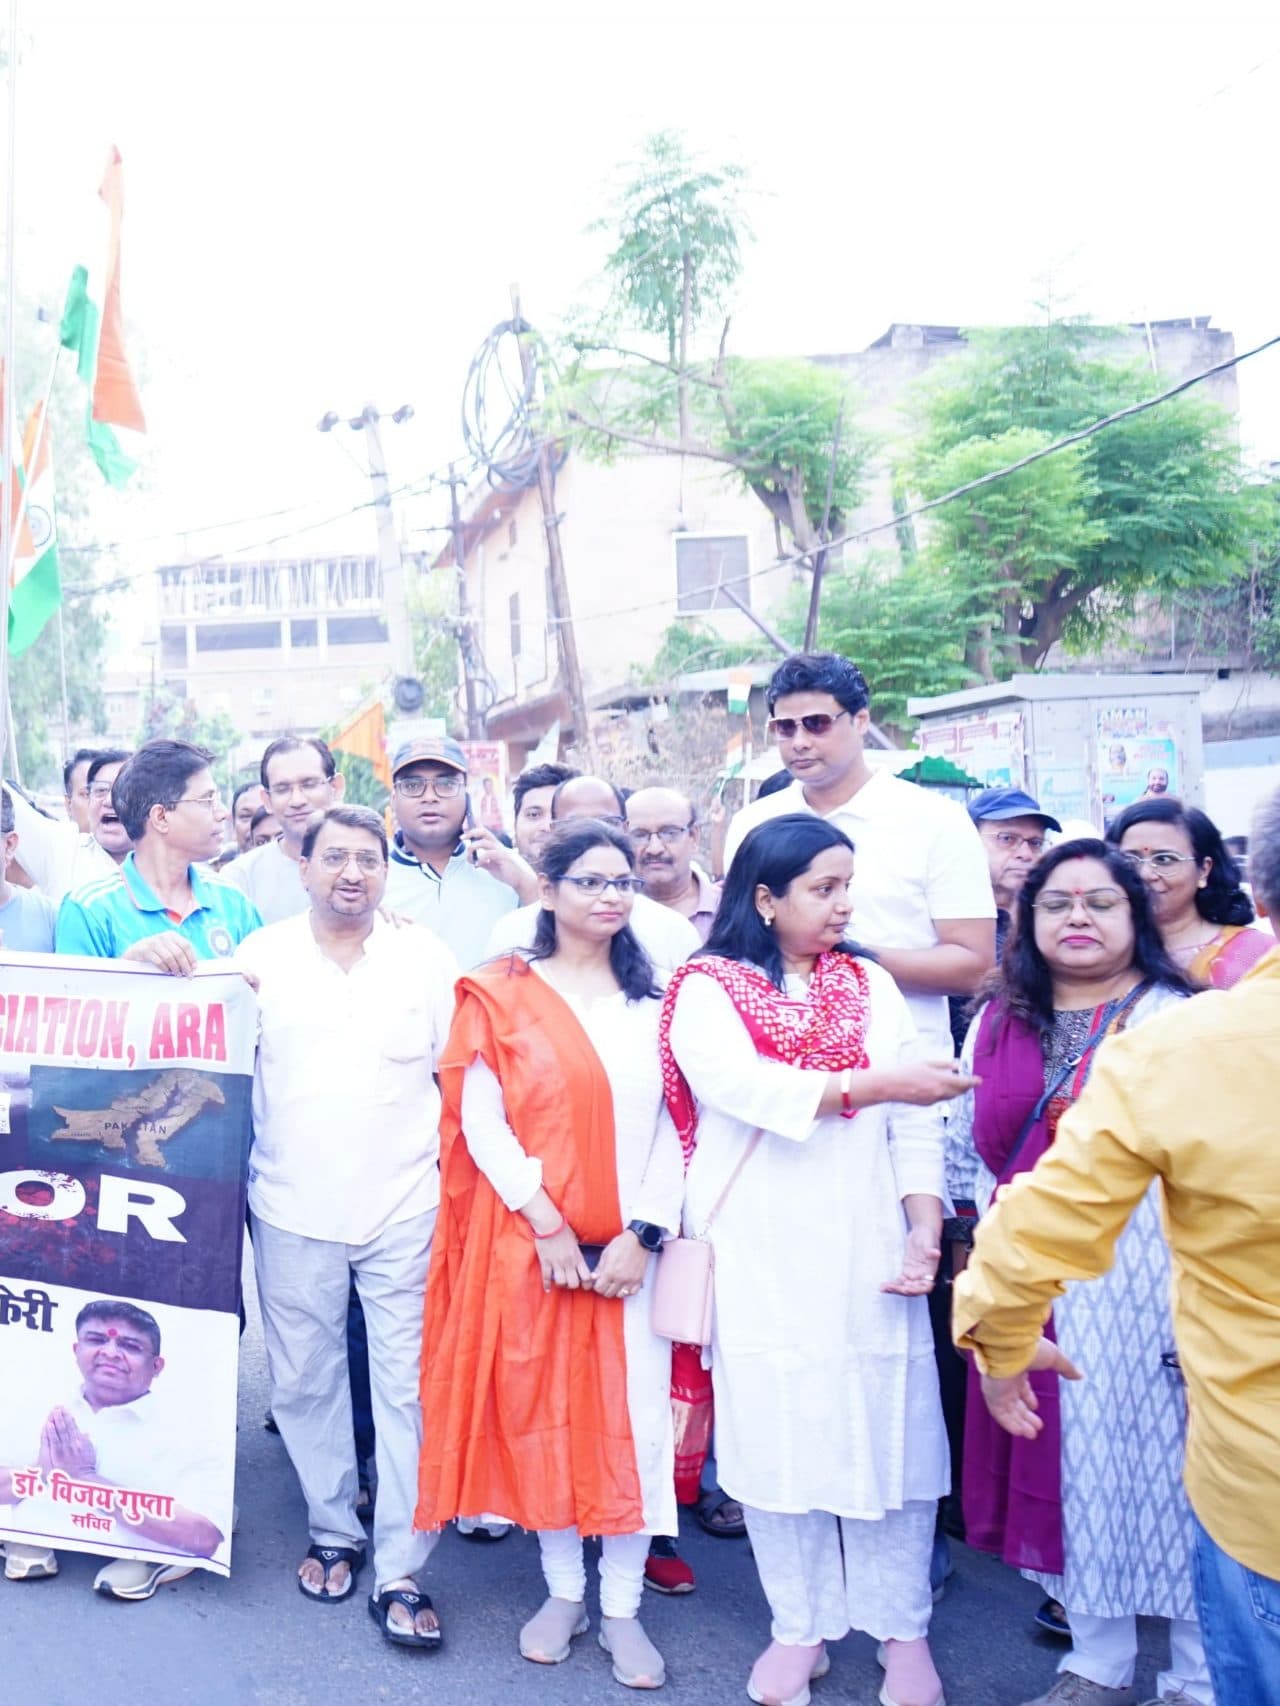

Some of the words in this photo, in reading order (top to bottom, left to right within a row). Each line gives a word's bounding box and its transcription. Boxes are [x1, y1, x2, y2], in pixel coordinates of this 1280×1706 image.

[149, 1001, 228, 1062] ARA
[104, 1120, 168, 1135] PAKTAN
[51, 1472, 114, 1510] विजय
[117, 1489, 175, 1522] गुप्ता
[71, 1513, 113, 1533] सचिव
